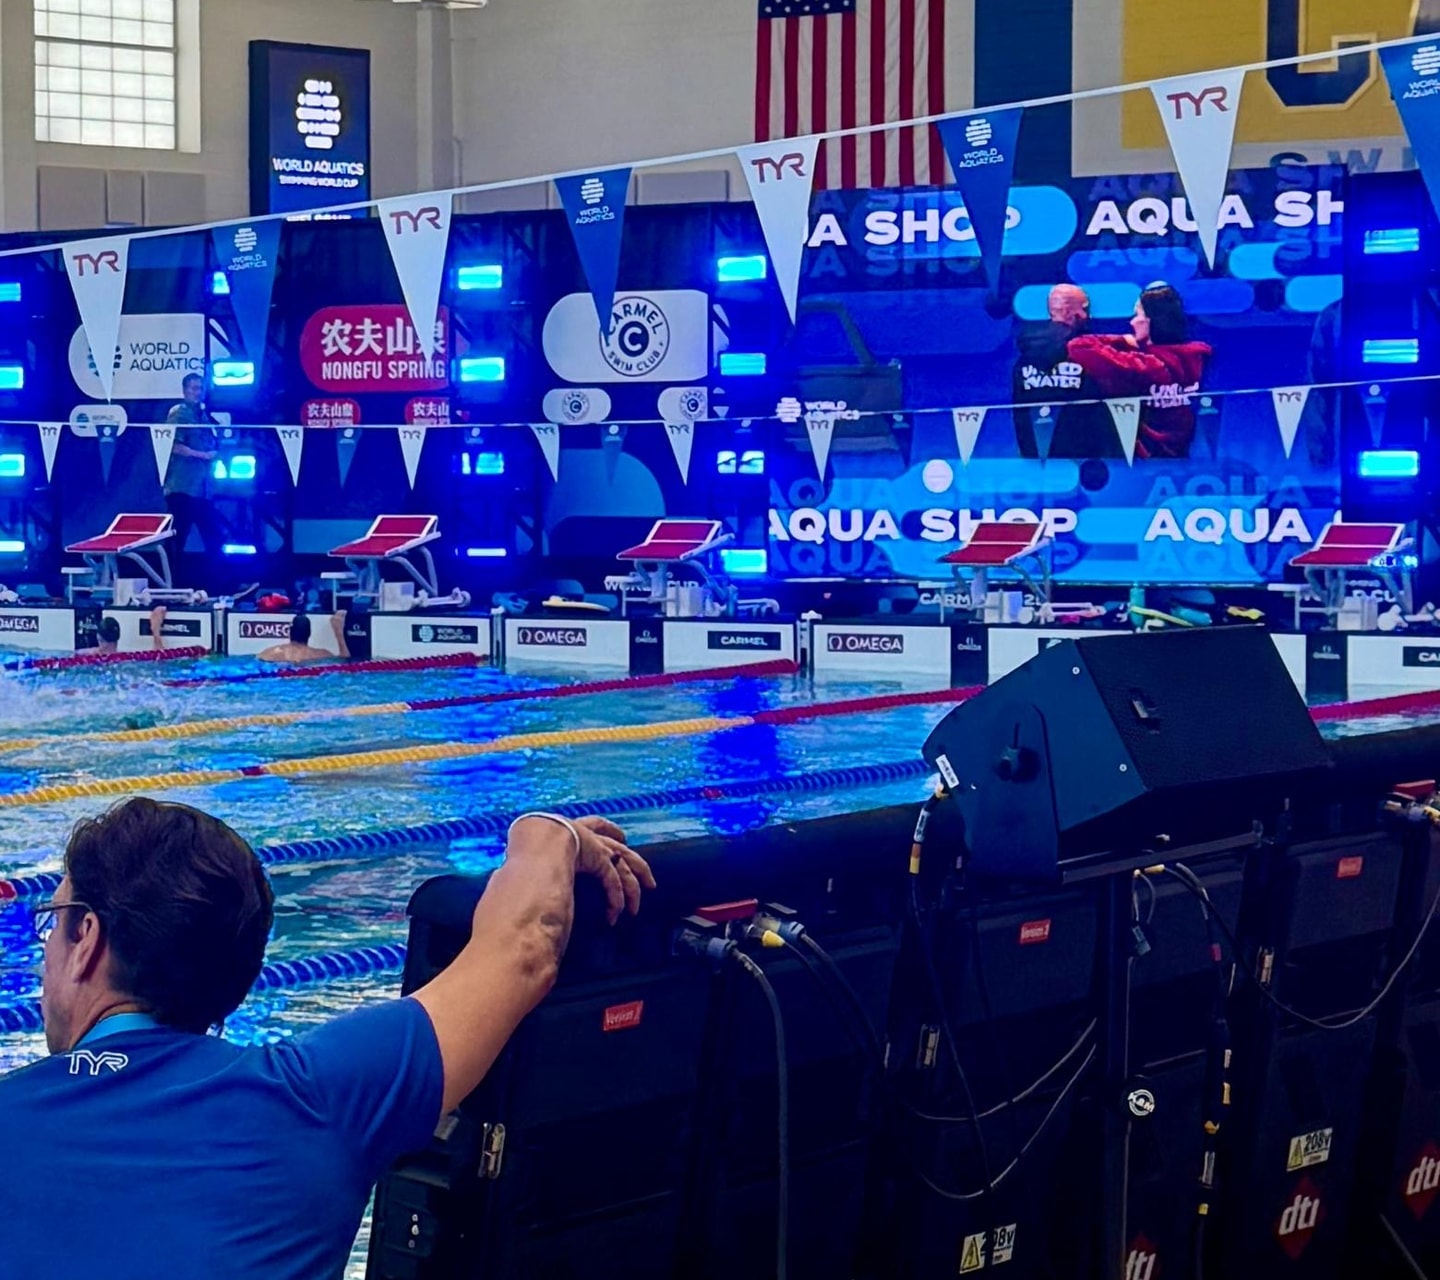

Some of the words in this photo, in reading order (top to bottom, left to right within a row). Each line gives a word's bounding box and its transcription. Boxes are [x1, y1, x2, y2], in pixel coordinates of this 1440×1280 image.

[1166, 86, 1229, 119] TYR
[964, 147, 997, 160] WORLD
[272, 157, 312, 173] WORLD
[314, 160, 365, 176] AQUATICS
[751, 152, 806, 183] TYR
[959, 154, 1004, 169] AQUATICS
[579, 206, 609, 217] WORLD
[1086, 194, 1254, 237] AQUA
[389, 206, 443, 234] TYR
[575, 212, 615, 225] AQUATICS
[72, 250, 120, 276] TYR
[228, 260, 267, 271] AQUATICS
[232, 254, 262, 264] WORLD
[608, 302, 660, 335] CARMEL
[623, 327, 642, 351] C
[130, 342, 189, 355] WORLD
[130, 357, 205, 371] AQUATICS
[608, 351, 632, 372] SWIM
[636, 350, 661, 371] CLUB
[322, 361, 382, 380] NONGFU
[388, 360, 445, 380] SPRING
[1277, 392, 1301, 402] TYR
[804, 401, 847, 411] WORLD
[1112, 403, 1135, 413] TYR
[957, 412, 979, 422] TYR
[154, 429, 171, 439] TYR
[281, 429, 299, 439] TYR
[403, 430, 421, 439] TYR
[668, 424, 690, 434] TYR
[769, 508, 900, 545] AQUA
[1144, 508, 1313, 545] AQUA
[254, 624, 290, 637] OMEG
[436, 627, 464, 635] WORLD
[534, 631, 586, 644] OMEGA
[720, 635, 768, 646] CARMEL
[846, 637, 903, 651] OMEGA
[65, 1049, 129, 1076] TYR
[1278, 1195, 1320, 1236] dti
